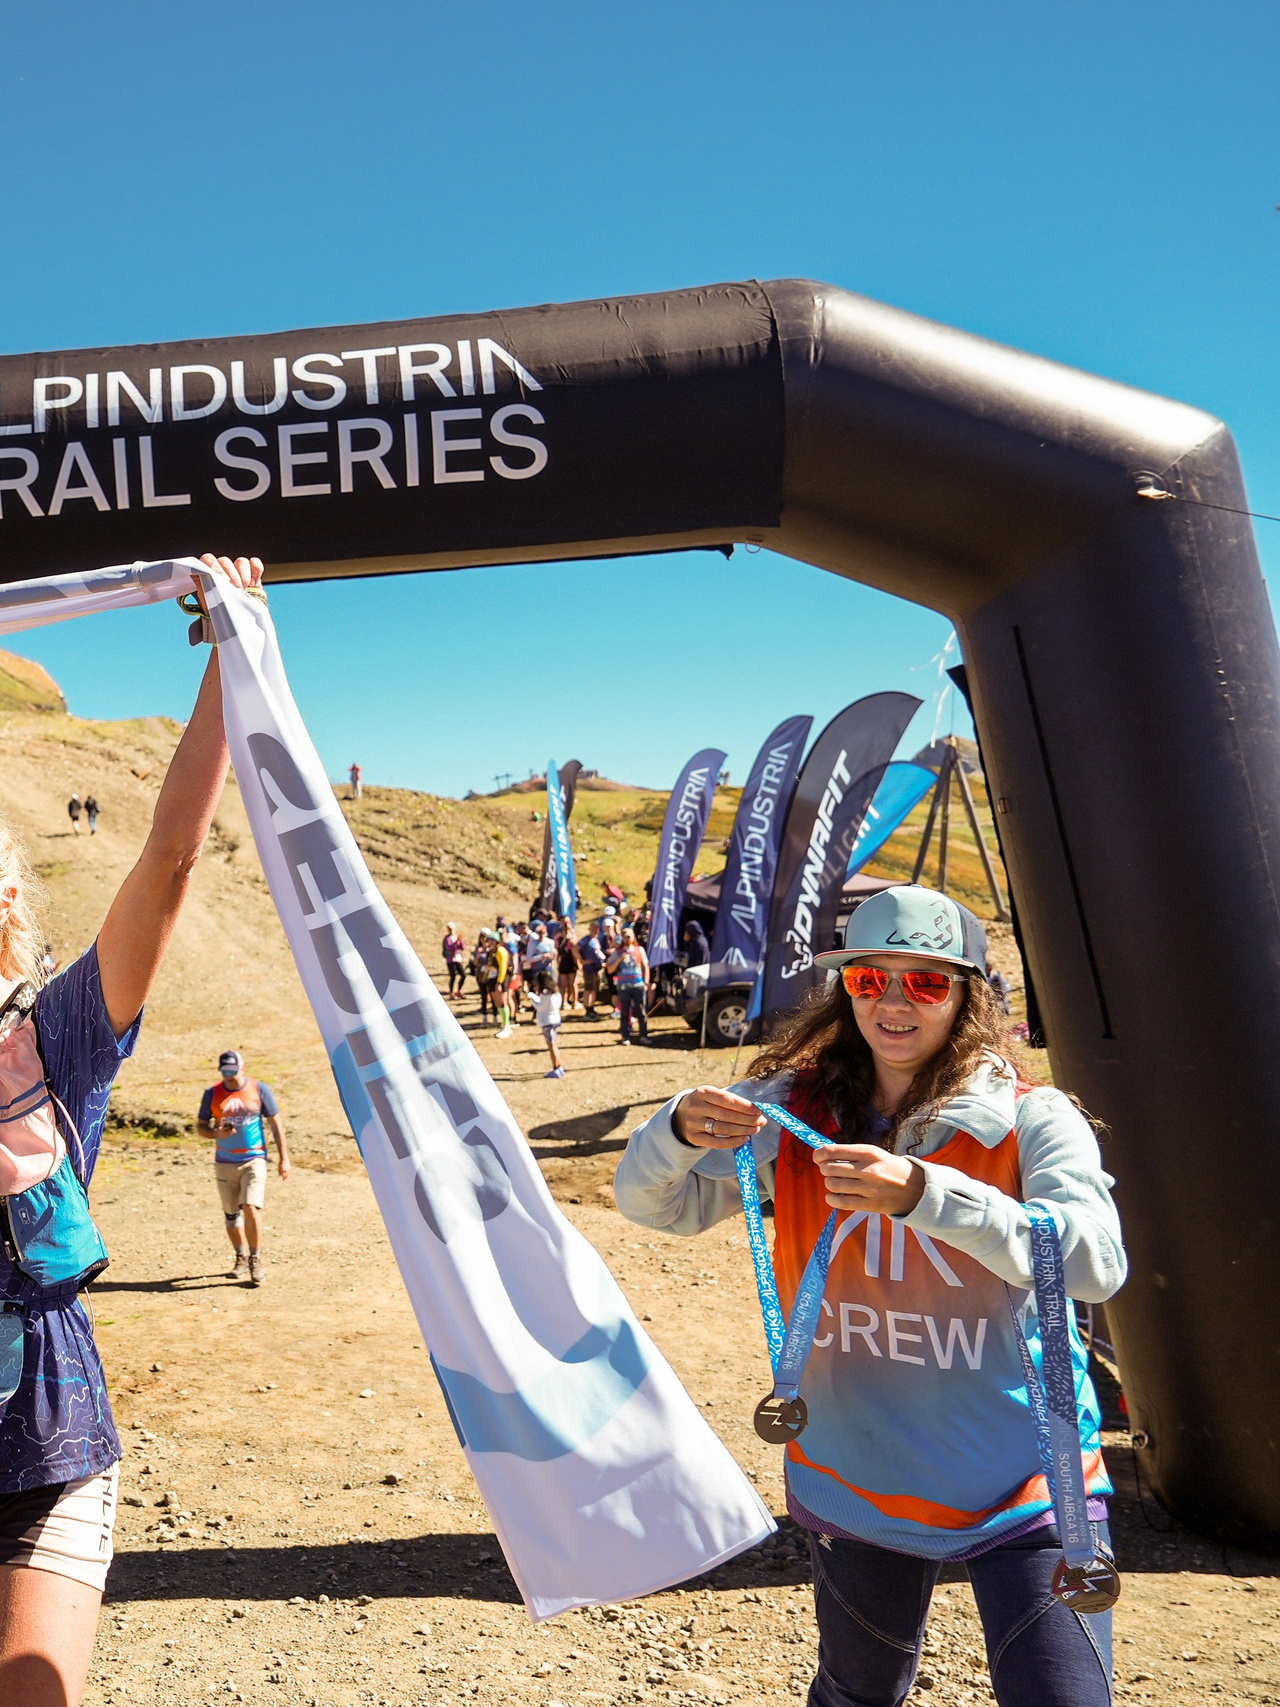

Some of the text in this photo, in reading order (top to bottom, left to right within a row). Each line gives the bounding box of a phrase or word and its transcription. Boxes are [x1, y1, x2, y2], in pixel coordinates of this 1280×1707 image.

[213, 404, 549, 501] SERIES
[550, 784, 569, 874] RAIDLIGHT
[662, 767, 709, 921] ALPINDUSTRIA
[730, 741, 793, 934] ALPINDUSTRIA
[794, 749, 851, 945] DYNAFIT
[741, 1161, 753, 1202] TRAIL
[748, 1203, 773, 1302] ALPINDUSTRIA
[782, 1291, 812, 1371] SOUTH AIBGA 16
[812, 1302, 988, 1371] CREW
[1045, 1292, 1060, 1334] TRAIL
[99, 1465, 113, 1554] HLIE
[1058, 1453, 1078, 1543] SOUTH AIBGA 16
